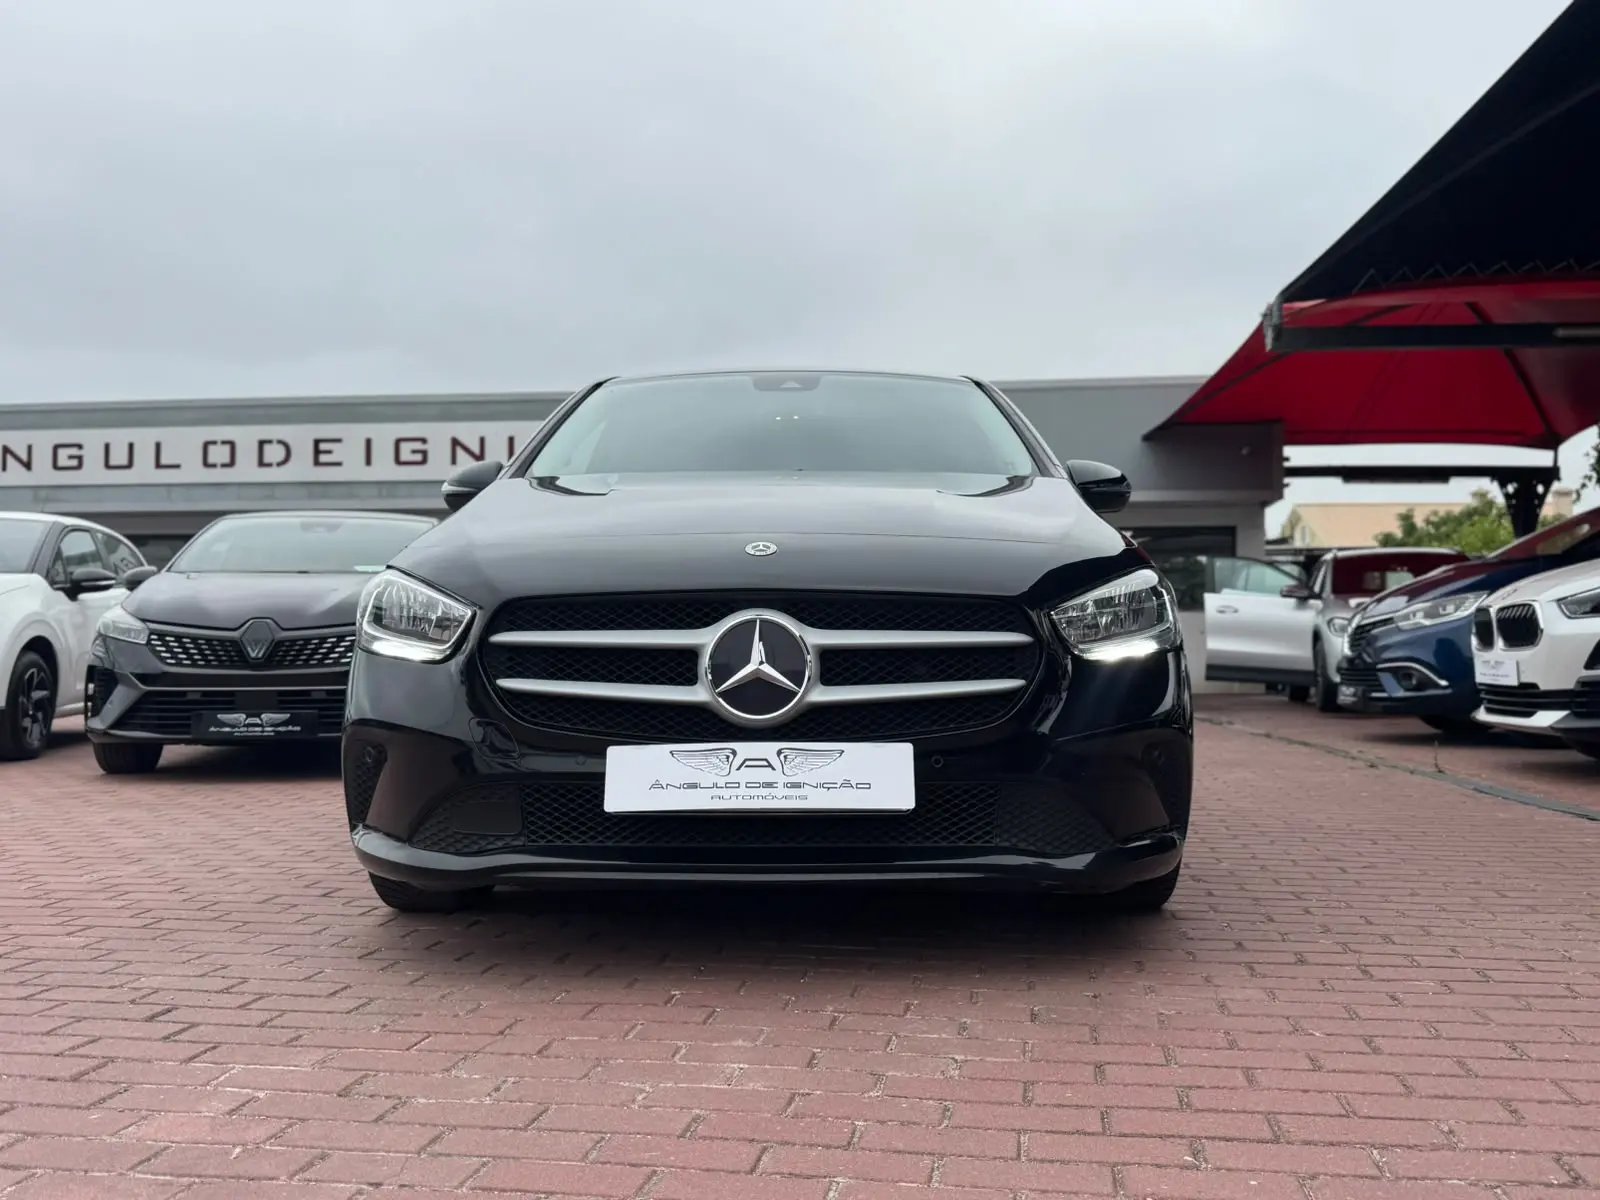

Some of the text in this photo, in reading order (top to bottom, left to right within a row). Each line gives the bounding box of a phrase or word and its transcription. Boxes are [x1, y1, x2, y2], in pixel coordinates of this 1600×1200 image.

[648, 779, 872, 791] ÂNGULO DE IGNIÇÃO
[710, 792, 808, 801] AUTOMÓVEIS
